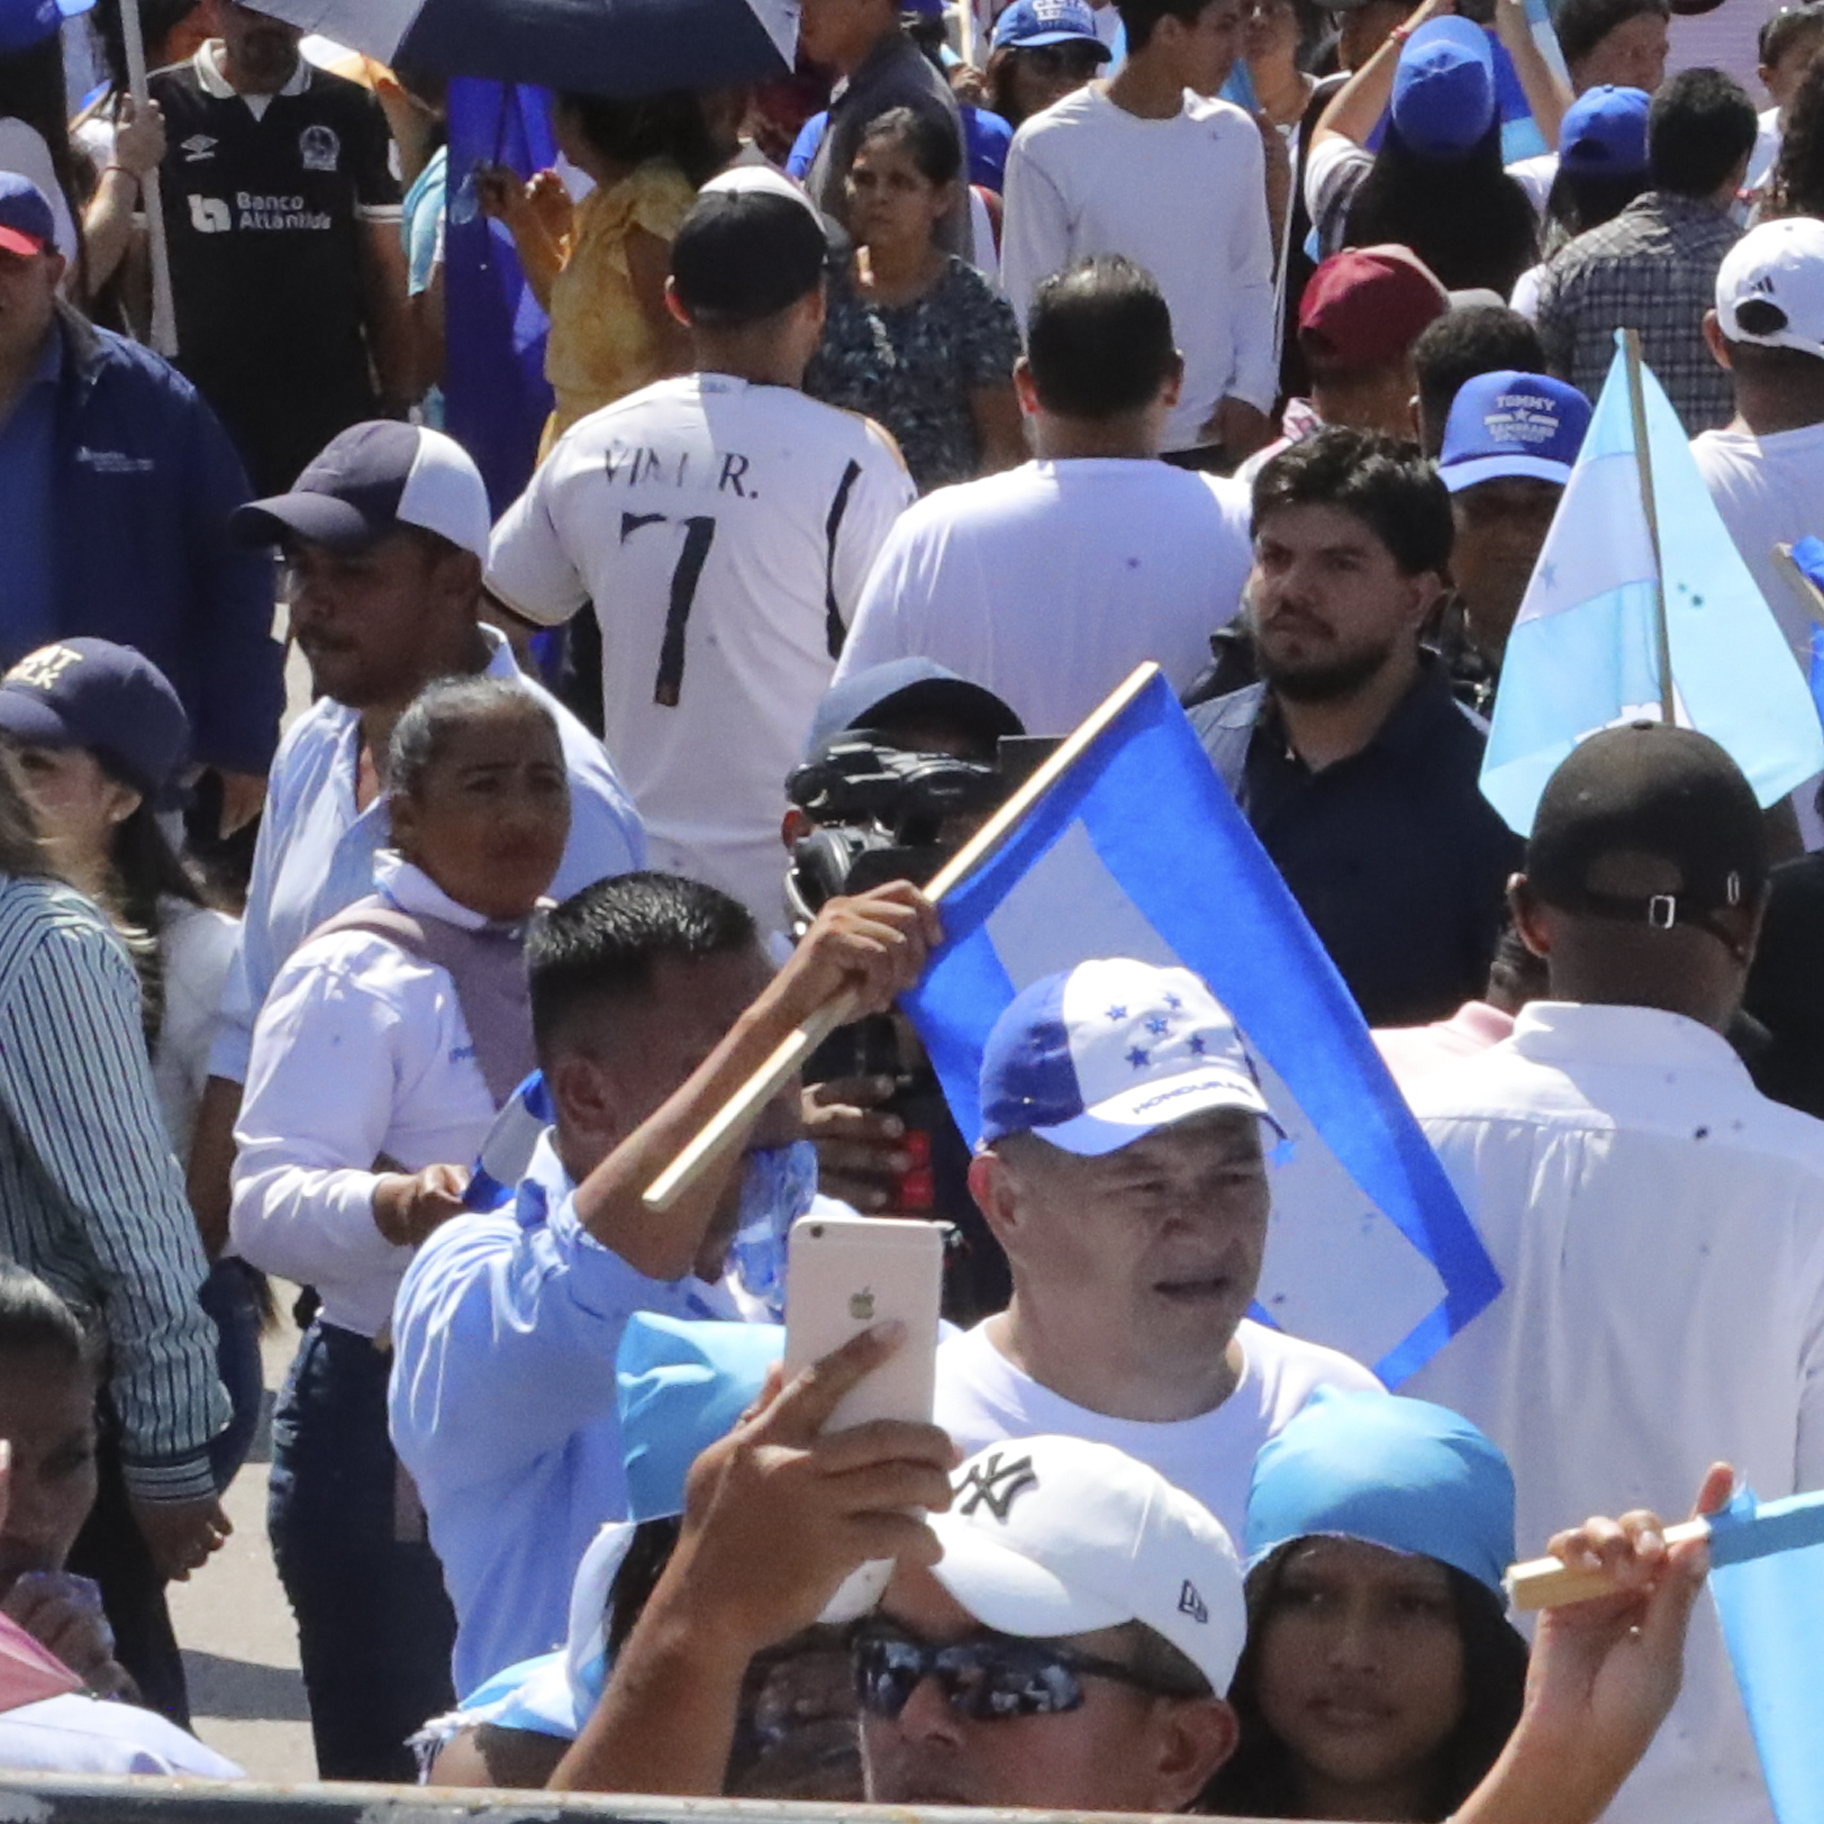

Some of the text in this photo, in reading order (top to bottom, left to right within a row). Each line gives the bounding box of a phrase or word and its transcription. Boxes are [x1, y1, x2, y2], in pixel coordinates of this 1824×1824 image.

[236, 190, 304, 211] Banco
[1496, 394, 1556, 411] TOMMY
[620, 511, 716, 707] 7
